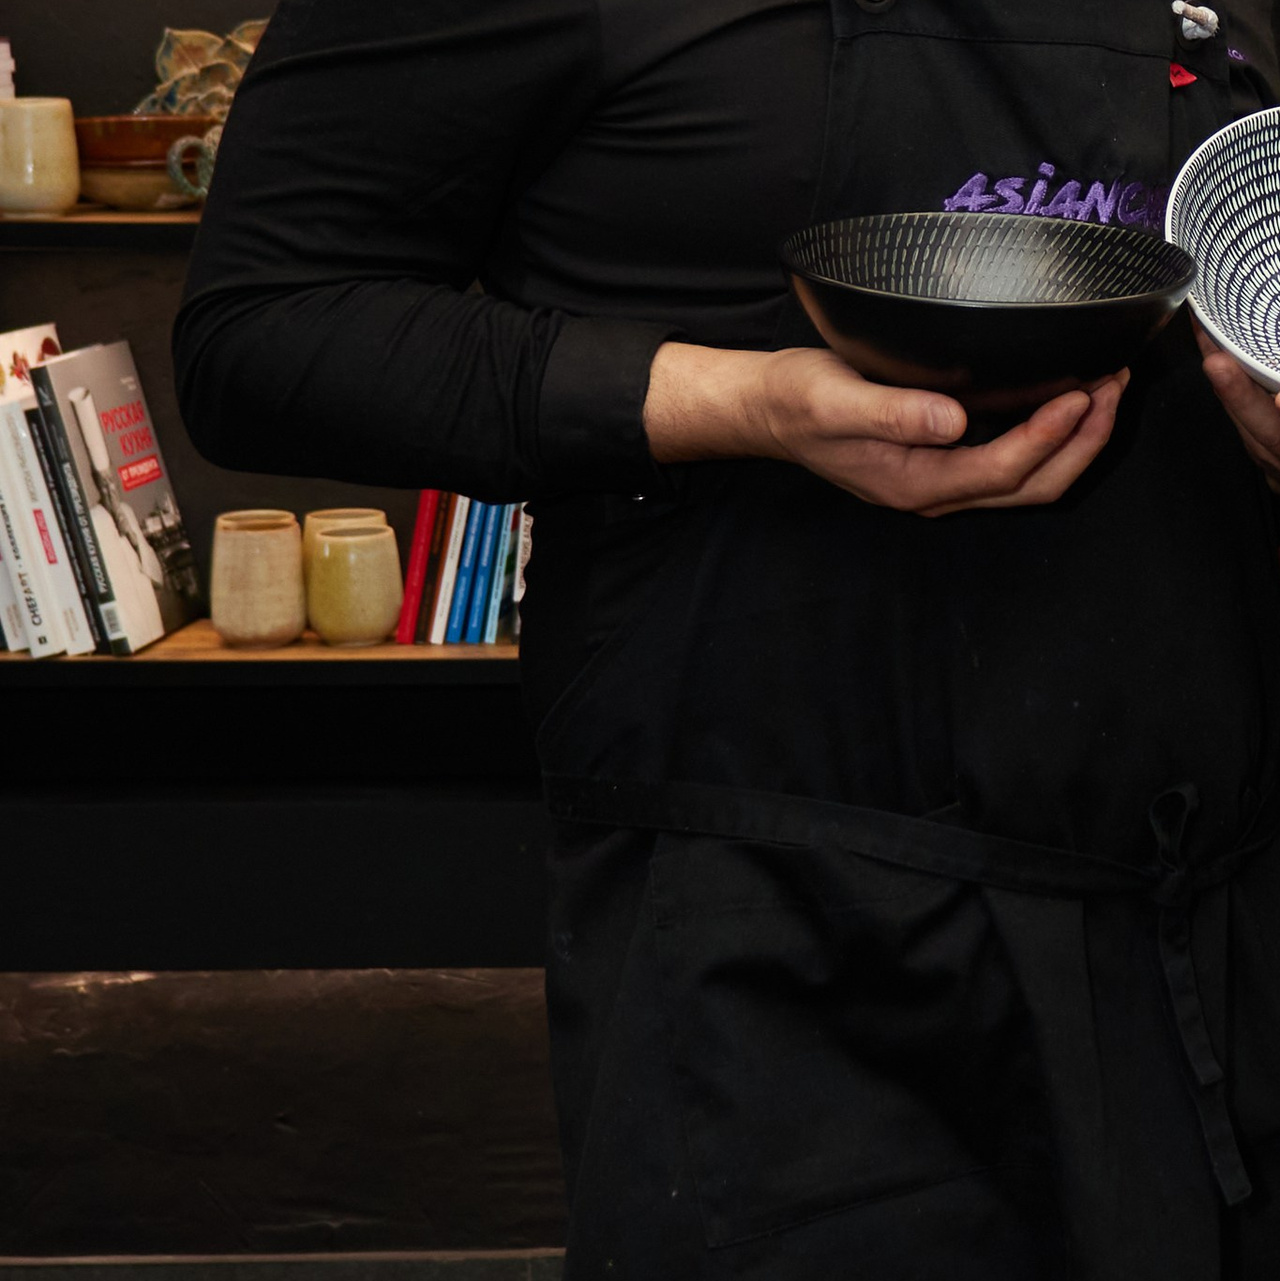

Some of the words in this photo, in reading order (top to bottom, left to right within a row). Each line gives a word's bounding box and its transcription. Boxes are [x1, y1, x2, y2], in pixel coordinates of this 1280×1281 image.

[100, 400, 145, 434] РУССКАЯ
[120, 426, 153, 457] КУХНЯ
[82, 527, 96, 555] КУХНЯ
[90, 556, 108, 593] РУССКАЯ
